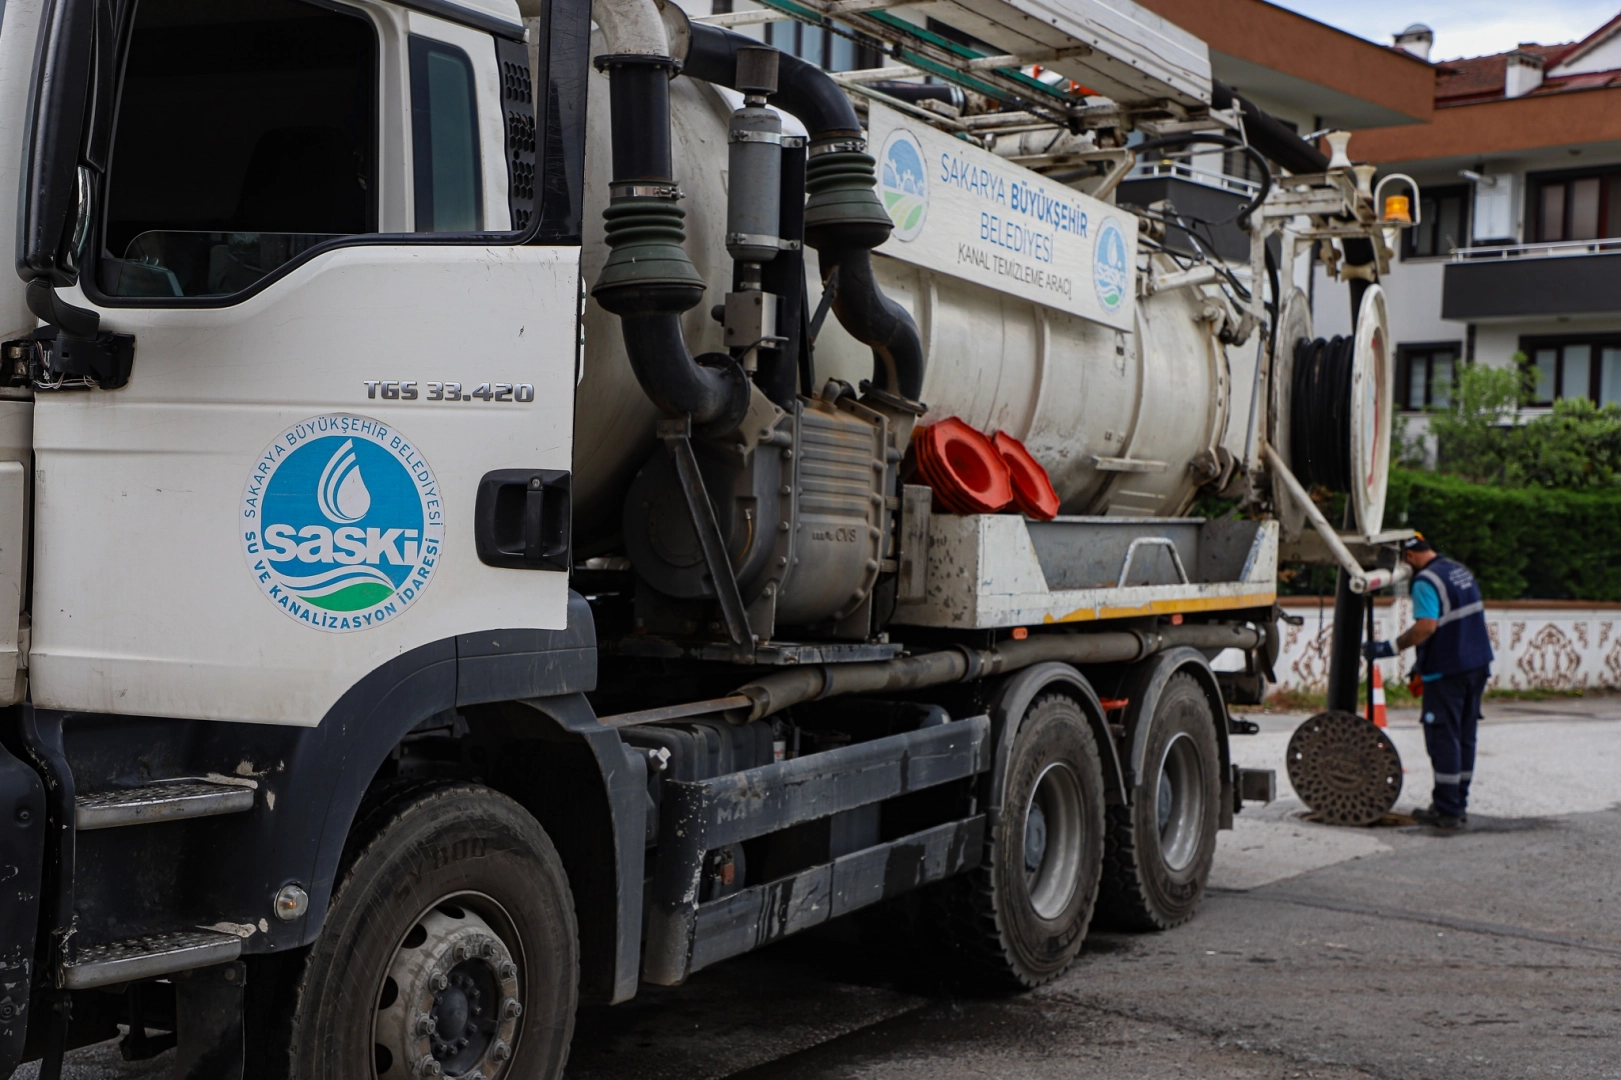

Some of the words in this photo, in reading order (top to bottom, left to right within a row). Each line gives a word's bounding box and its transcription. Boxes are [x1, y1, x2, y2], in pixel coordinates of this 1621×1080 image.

[940, 153, 1006, 206] SAKARYA
[1011, 180, 1088, 238] BÜYÜKŞEHİR
[958, 242, 990, 271] KANAL
[993, 254, 1044, 288] TEMİZLEME
[1046, 273, 1072, 296] ARACI
[980, 211, 1053, 264] BELEDİYESİ
[363, 380, 418, 400] TGS
[426, 381, 535, 402] 33.420
[244, 444, 286, 519] SAKARYA
[286, 416, 388, 446] BÜYÜKŞEHİR
[390, 436, 444, 526] BELEDİYESİ
[244, 531, 259, 554] SU
[254, 559, 271, 584] VE
[269, 584, 397, 629] KANALİZASYON
[396, 538, 440, 605] İDARESİ
